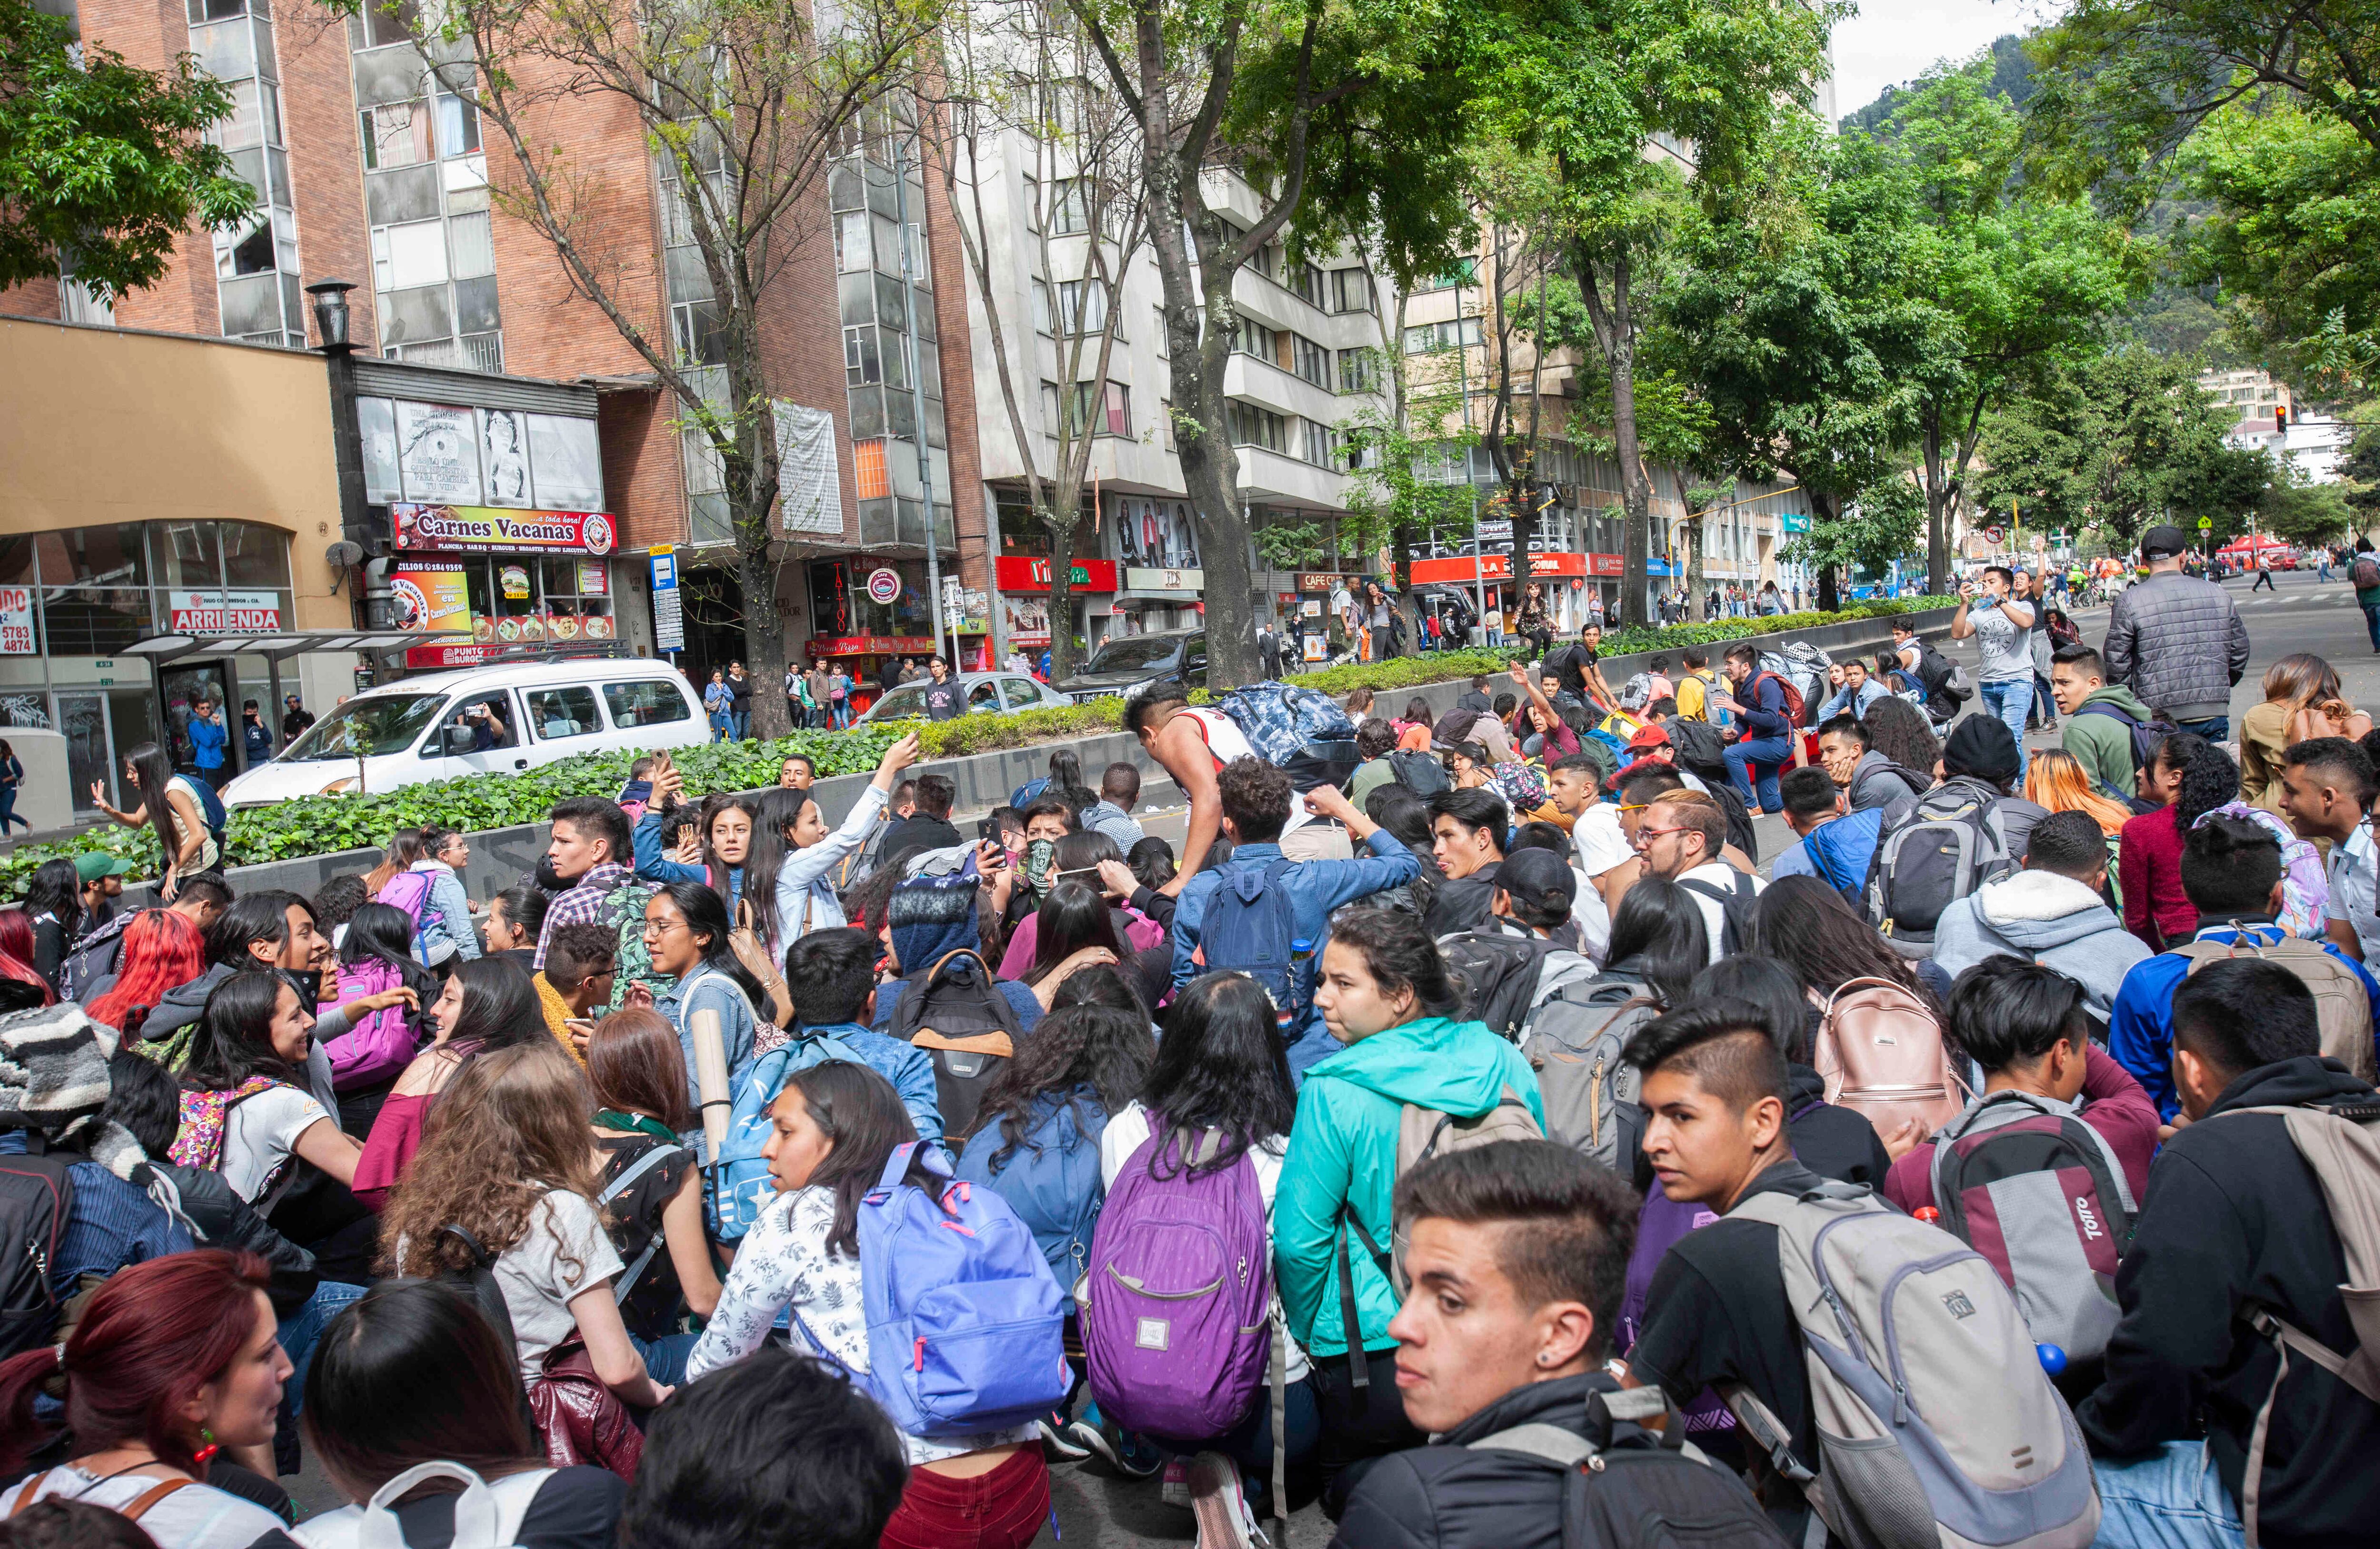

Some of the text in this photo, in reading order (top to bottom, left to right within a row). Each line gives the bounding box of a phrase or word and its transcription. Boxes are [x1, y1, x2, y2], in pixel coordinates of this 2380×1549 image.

[415, 473, 434, 481] PARA
[545, 514, 561, 523] toda
[562, 514, 582, 524] hora!
[417, 513, 575, 541] Carnes Vacanas
[584, 515, 611, 537] Carnes Vacanas
[397, 562, 462, 572] CILIOS 284 9359
[1481, 562, 1498, 573] LA
[1305, 575, 1326, 585] CAFE
[399, 581, 426, 610] Vacanas
[176, 610, 278, 629] ARRIENDA
[430, 608, 447, 620] Carnes
[2, 626, 29, 639] 5783
[1981, 620, 2010, 636] BRIXTON
[4, 640, 31, 651] 4874
[839, 641, 859, 653] Pizza
[1982, 640, 2011, 655] SUPPLY
[929, 691, 951, 701] CANTON
[2075, 1196, 2103, 1241] TOTTO
[1165, 1469, 1181, 1477] NIKE
